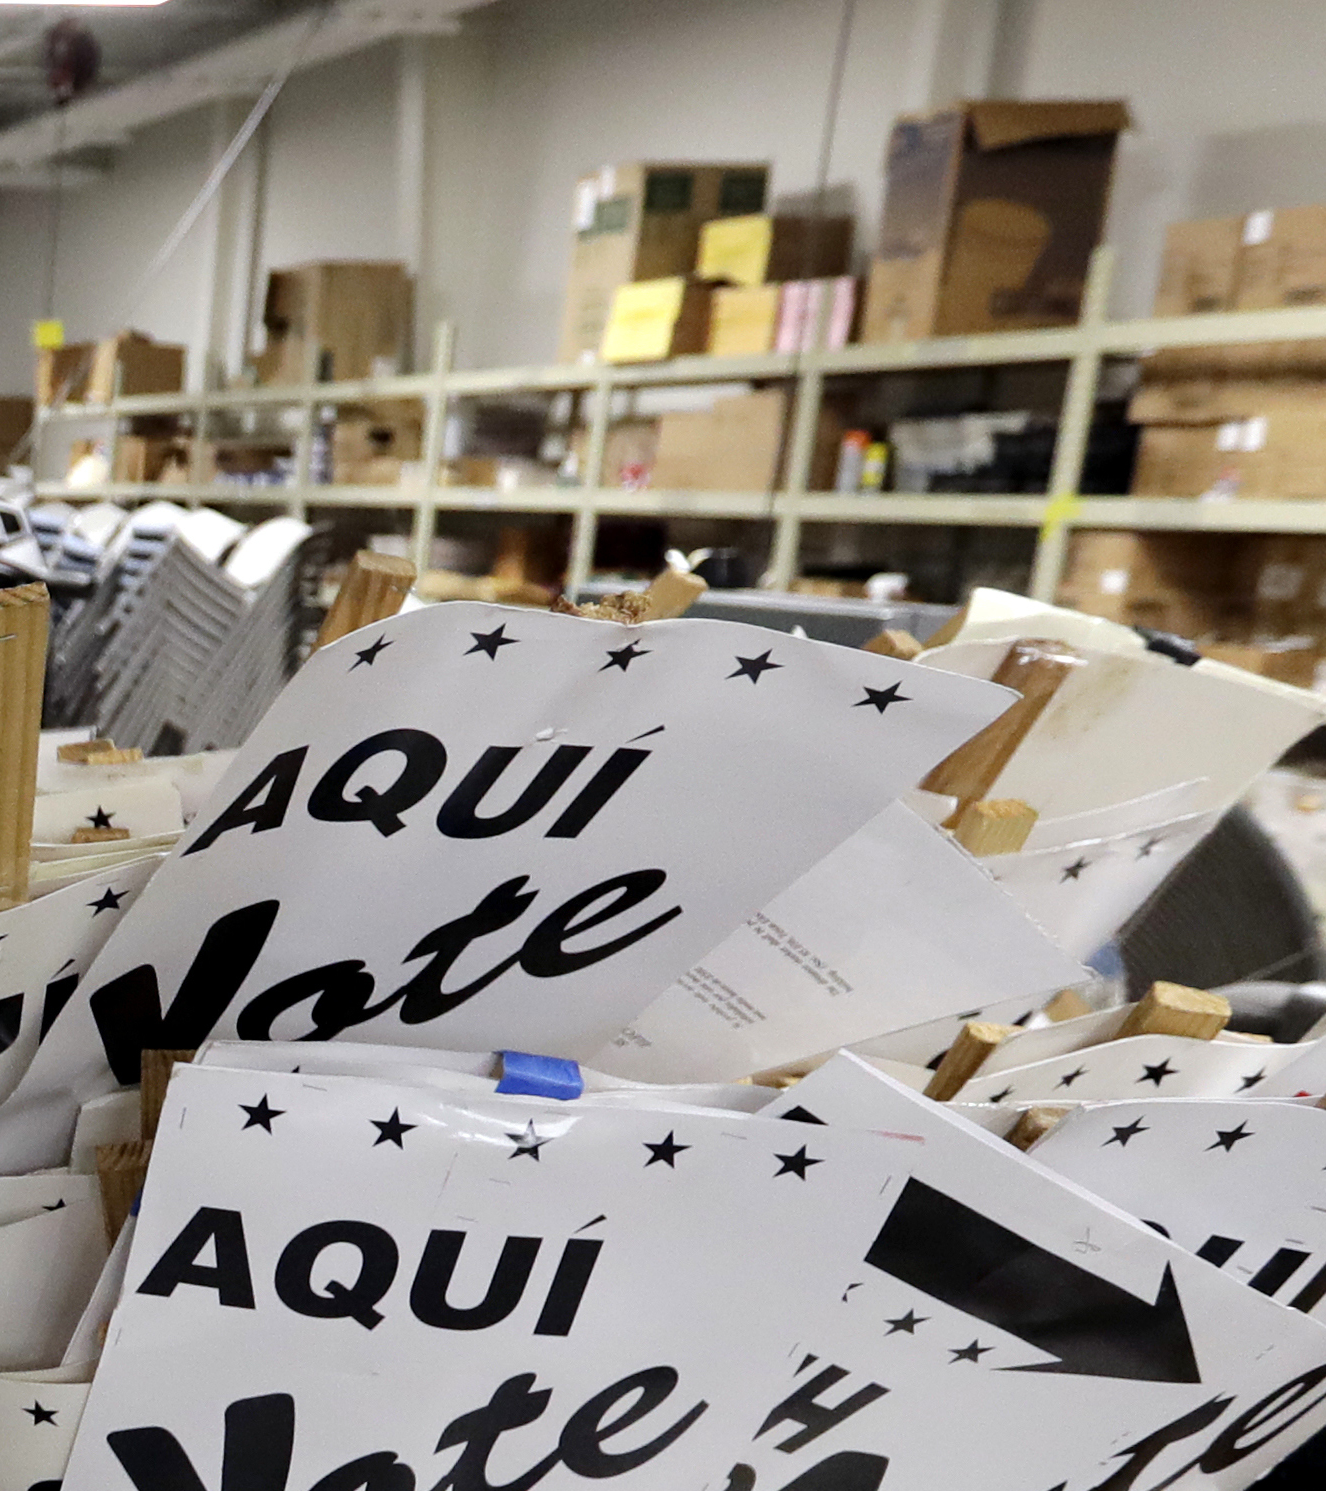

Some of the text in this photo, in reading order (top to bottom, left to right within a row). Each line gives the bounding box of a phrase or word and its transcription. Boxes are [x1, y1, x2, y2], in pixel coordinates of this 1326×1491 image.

[180, 725, 665, 857] AQUÍ
[90, 868, 682, 1087] Vote
[135, 1206, 607, 1337] AQUÍ
